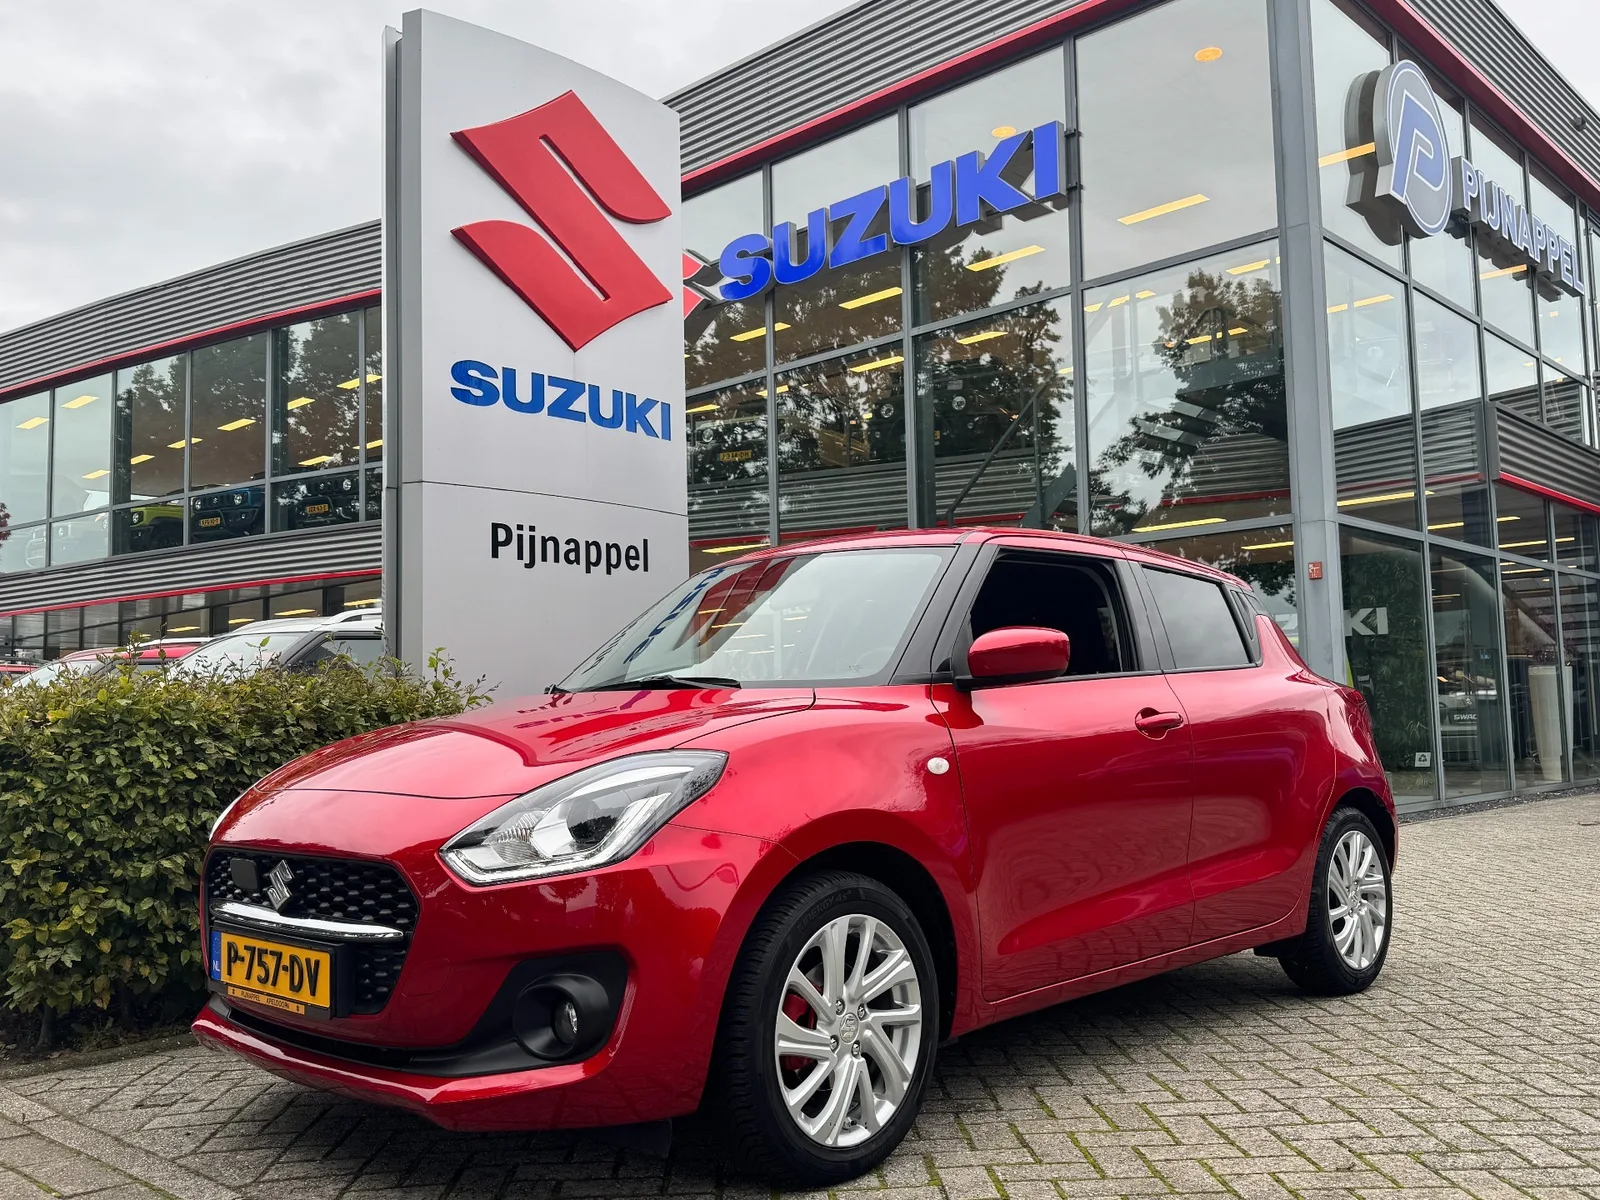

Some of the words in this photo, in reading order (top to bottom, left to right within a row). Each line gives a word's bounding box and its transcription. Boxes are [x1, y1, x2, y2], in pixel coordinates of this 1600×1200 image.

[718, 119, 1065, 301] SUZUKI
[1460, 156, 1585, 296] PIJNAPPEL
[450, 359, 672, 441] SUZUKI
[490, 522, 650, 575] Pijnappel
[212, 959, 221, 972] NL
[226, 941, 321, 997] P-757-DV
